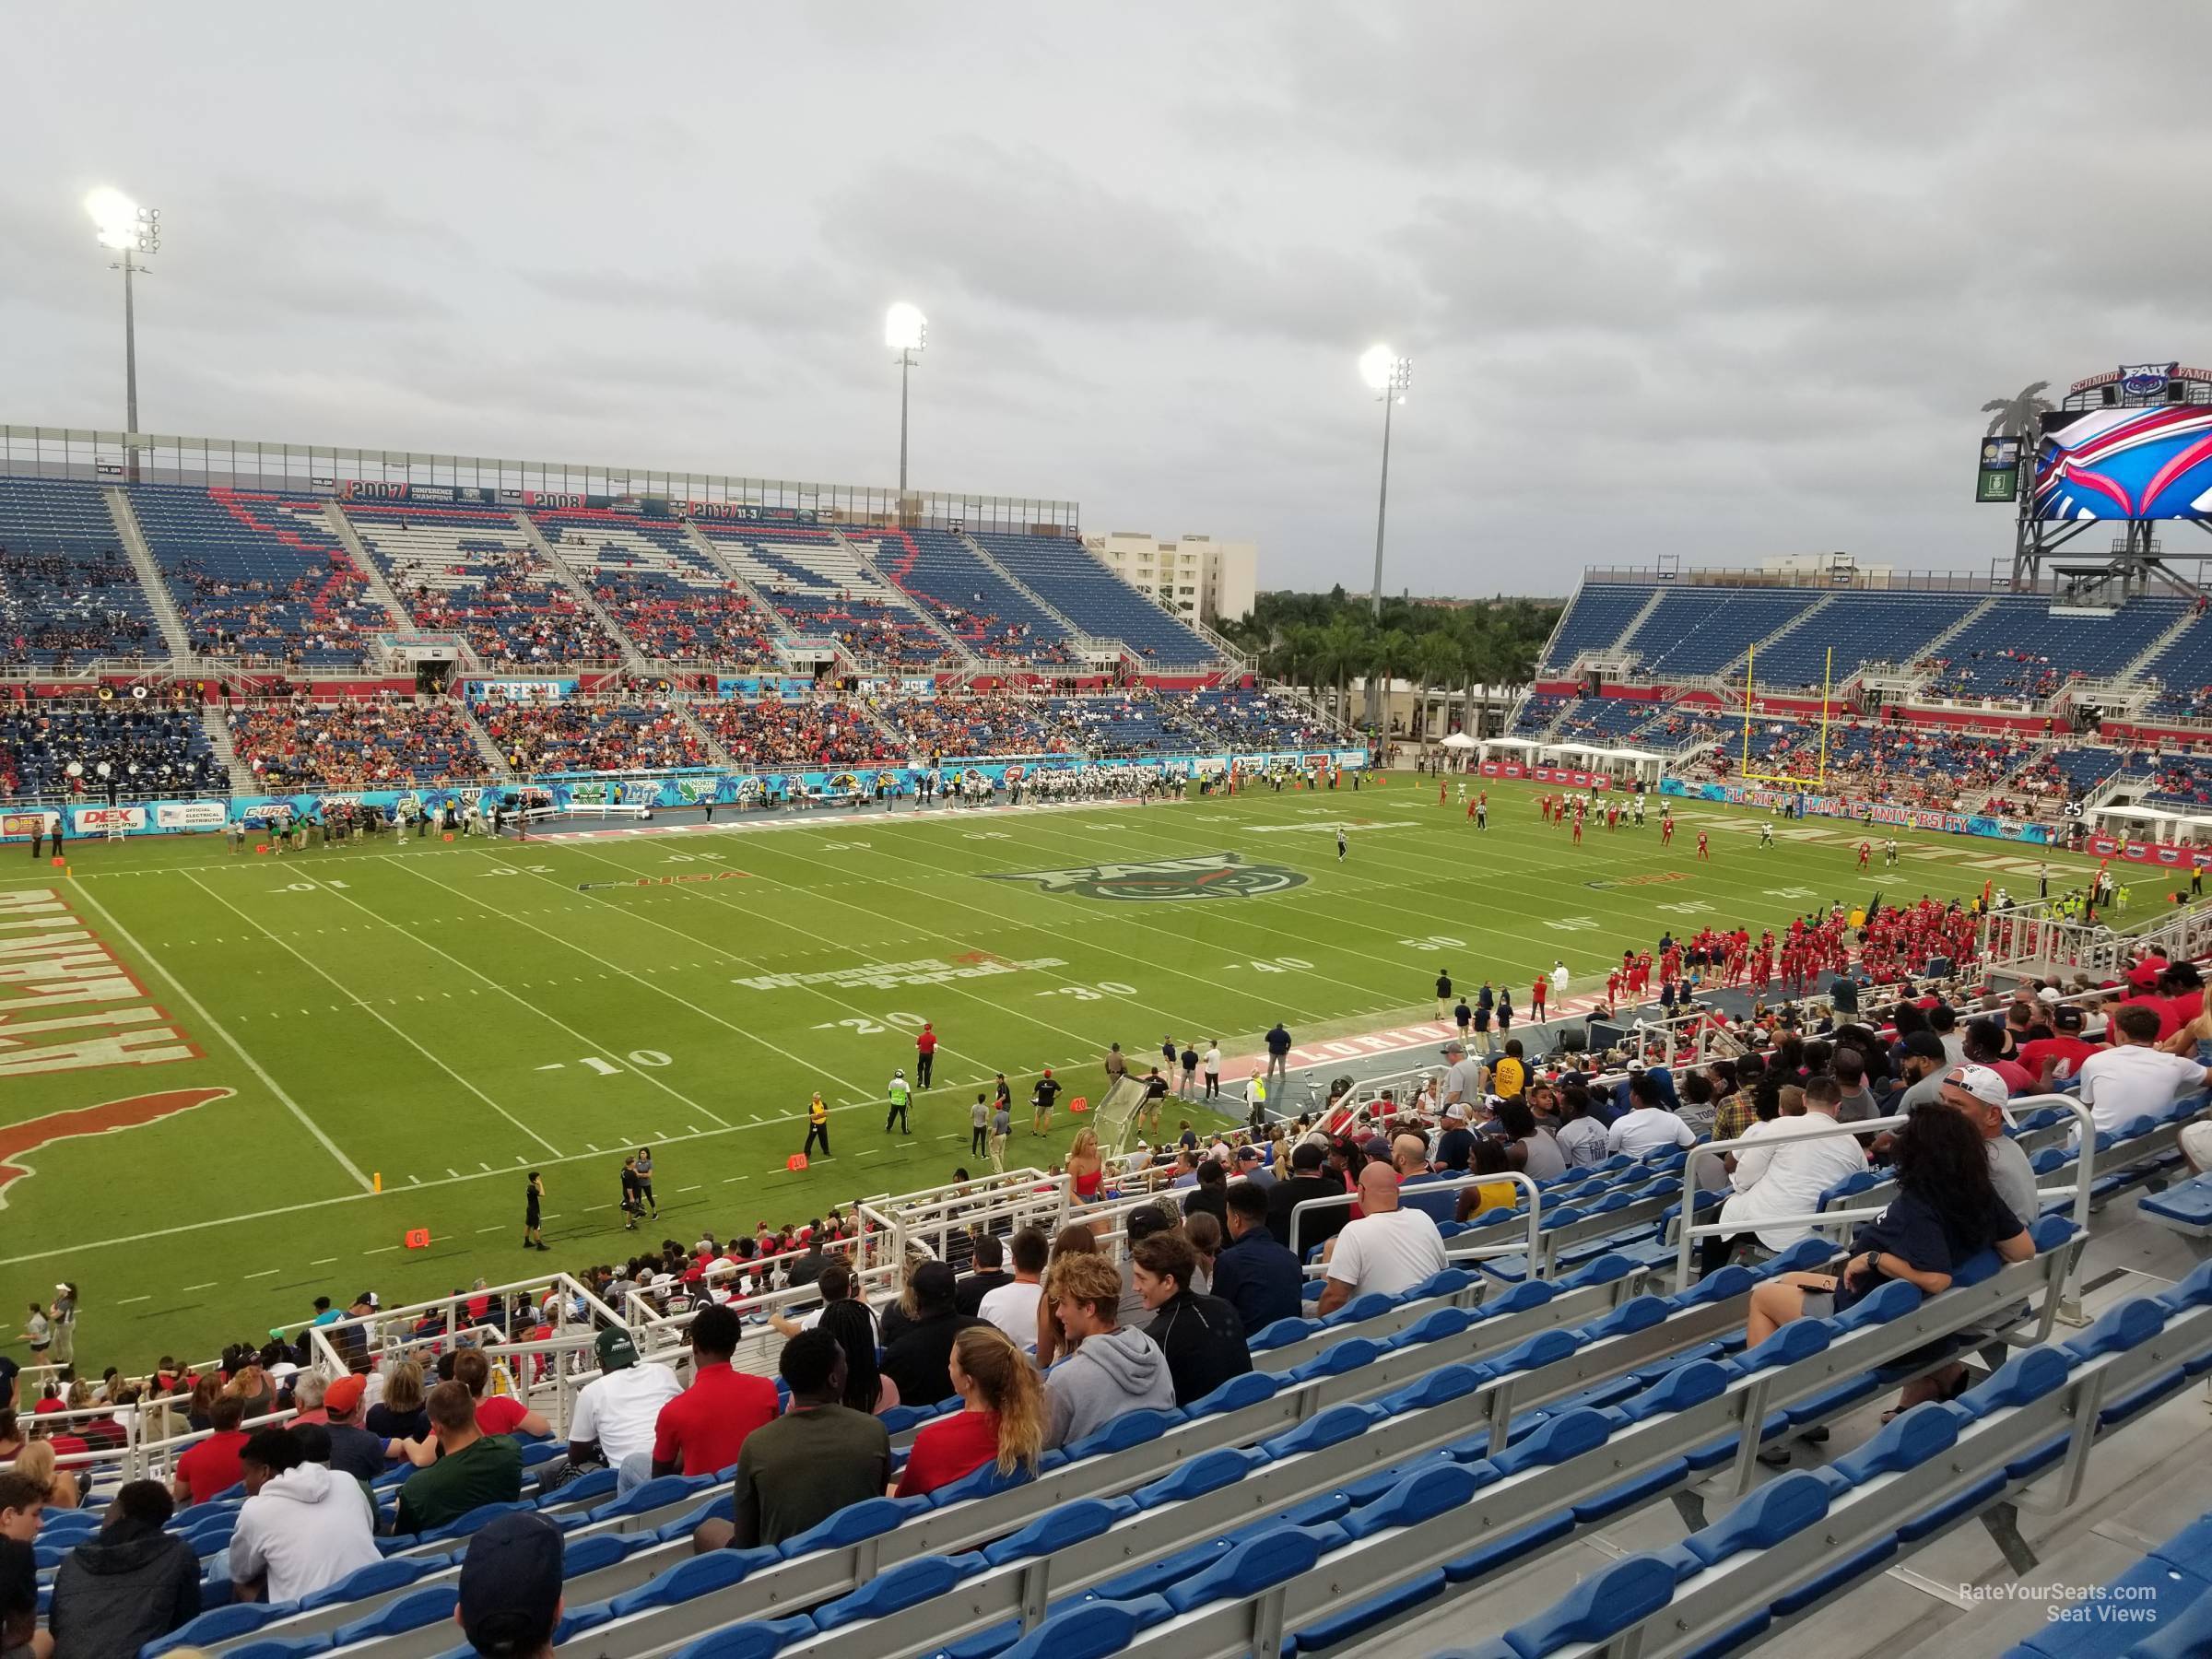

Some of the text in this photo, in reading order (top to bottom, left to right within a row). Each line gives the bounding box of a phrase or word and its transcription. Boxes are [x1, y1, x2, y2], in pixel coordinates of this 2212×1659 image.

[2071, 371, 2117, 394] SCHMIDT
[351, 480, 404, 499] 2007
[411, 487, 454, 496] CONFERENCE
[411, 493, 454, 502] CHAMPIONS
[535, 493, 582, 508] 2008
[693, 502, 734, 517] 2017
[737, 508, 758, 519] 11-3
[2065, 802, 2082, 817] 25
[1397, 935, 1468, 951] 50
[1248, 956, 1316, 975] 40
[731, 958, 954, 991] Winning
[1057, 981, 1139, 1002] 30
[839, 1012, 932, 1036] 20
[579, 1049, 674, 1077] 10
[1500, 1066, 1515, 1075] CSC
[1076, 1100, 1086, 1110] 20
[794, 1156, 805, 1167] 10
[414, 1233, 421, 1243] G
